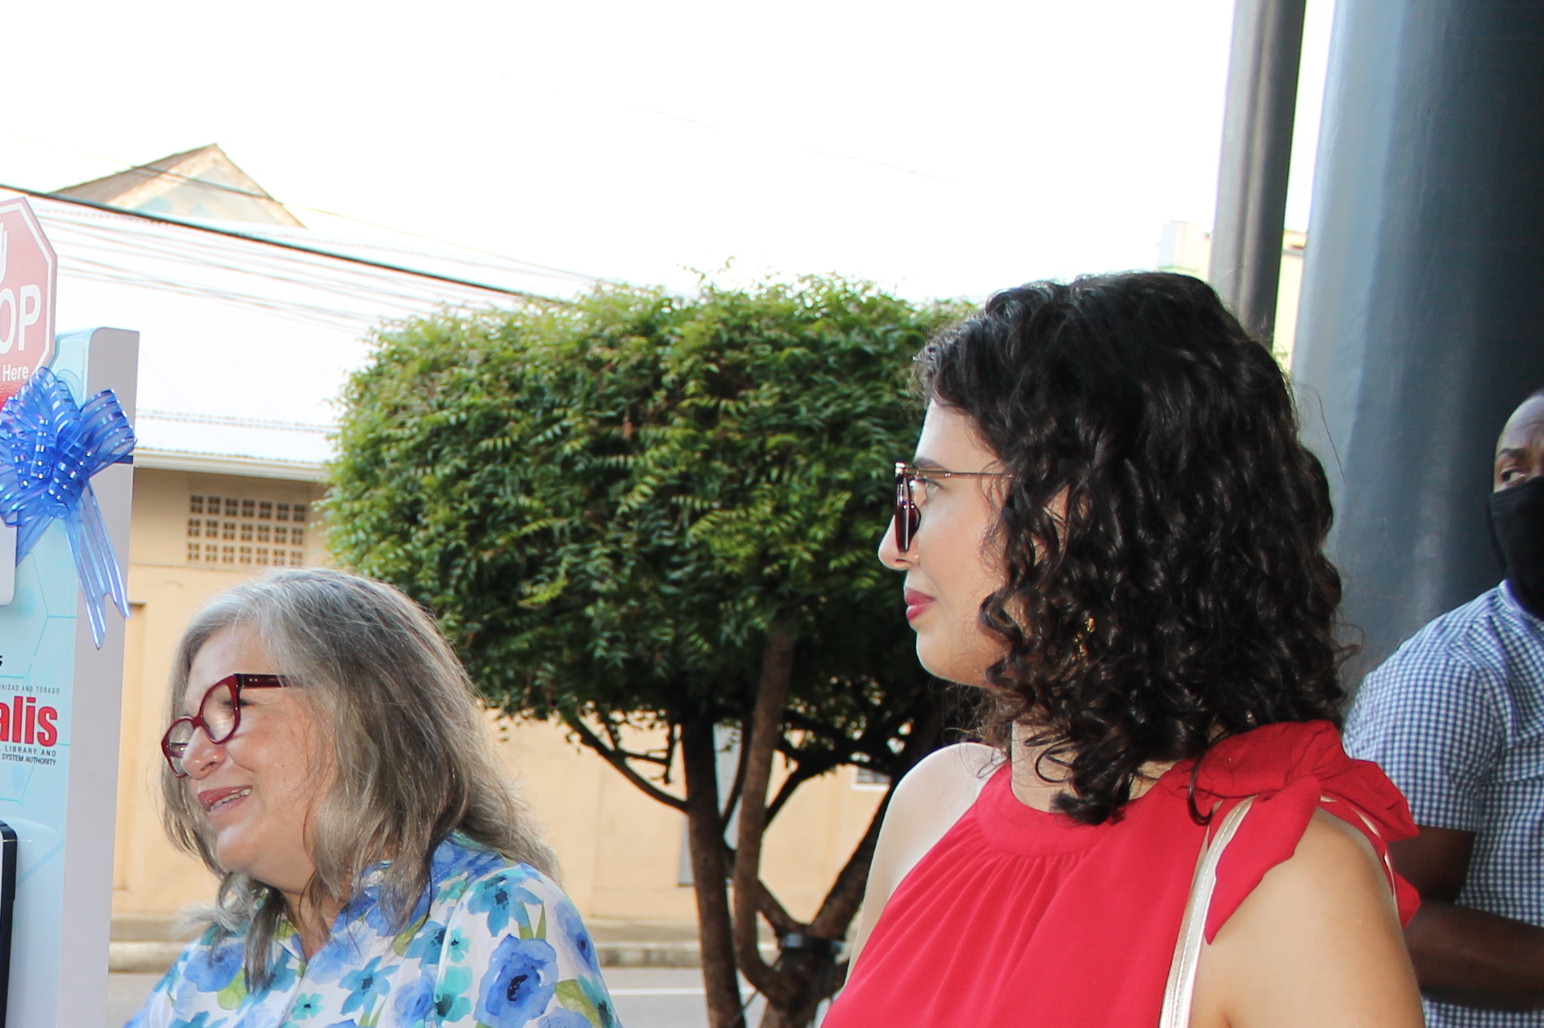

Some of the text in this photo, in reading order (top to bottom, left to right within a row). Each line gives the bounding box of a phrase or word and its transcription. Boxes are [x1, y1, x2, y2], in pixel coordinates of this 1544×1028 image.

[2, 364, 29, 382] Here
[22, 685, 33, 693] AND
[36, 686, 60, 695] TOBAGO
[5, 745, 37, 755] LIBRARY
[40, 749, 56, 757] AND
[2, 753, 24, 762] SYSTEM
[25, 756, 56, 766] AUTHORITY
